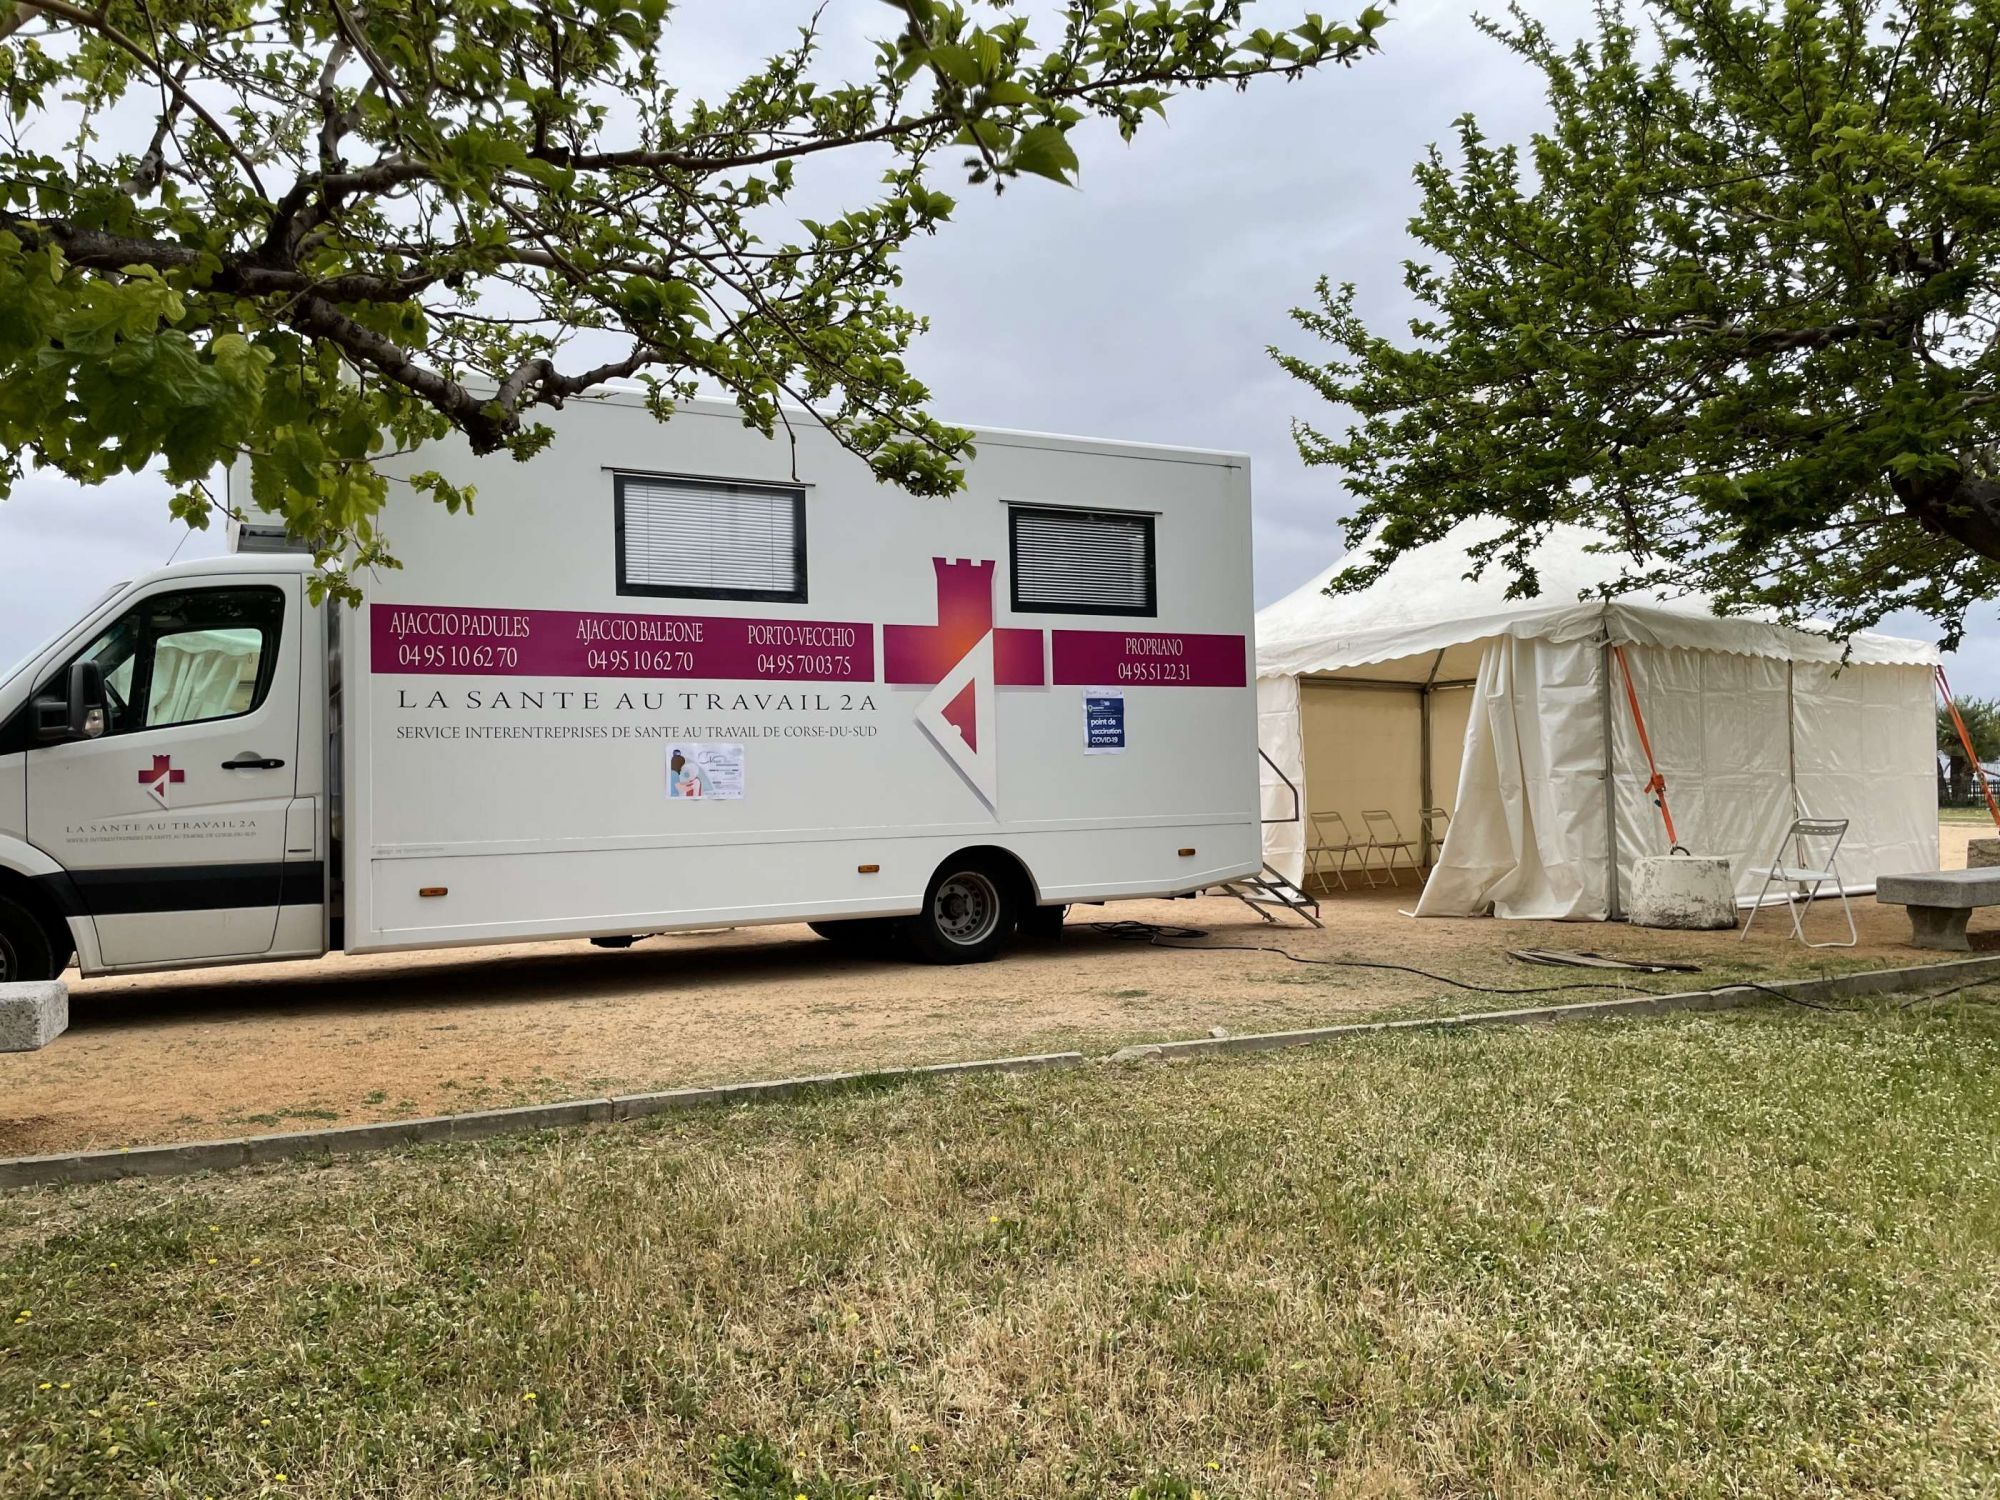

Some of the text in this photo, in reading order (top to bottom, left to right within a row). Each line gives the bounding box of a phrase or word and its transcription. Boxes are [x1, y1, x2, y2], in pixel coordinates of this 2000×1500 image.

[389, 612, 530, 640] AJACCIO PADULES
[576, 619, 704, 646] AJACCIO BALEONE
[747, 625, 855, 648] PORTO-VECCHIO
[398, 644, 517, 667] 04 95 10 62 70
[1125, 637, 1183, 656] PROPRIANO
[588, 649, 694, 671] 04 95 10 62 70
[757, 654, 851, 675] 04 95 70 03 75
[1118, 662, 1190, 680] 04 95 51 22 31
[397, 689, 878, 711] LA SANTE AU TRAVAIL 2A
[396, 725, 877, 739] SERVICE INTERENTREPRISES DE SANTE AU TRAVAIL DE CORSE-DU-SUD
[1091, 717, 1116, 727] point de
[1091, 727, 1122, 735] vaccination
[91, 824, 142, 832] SANTE
[147, 823, 166, 831] AU
[171, 821, 236, 830] TRAVAIL
[240, 820, 256, 828] 2A
